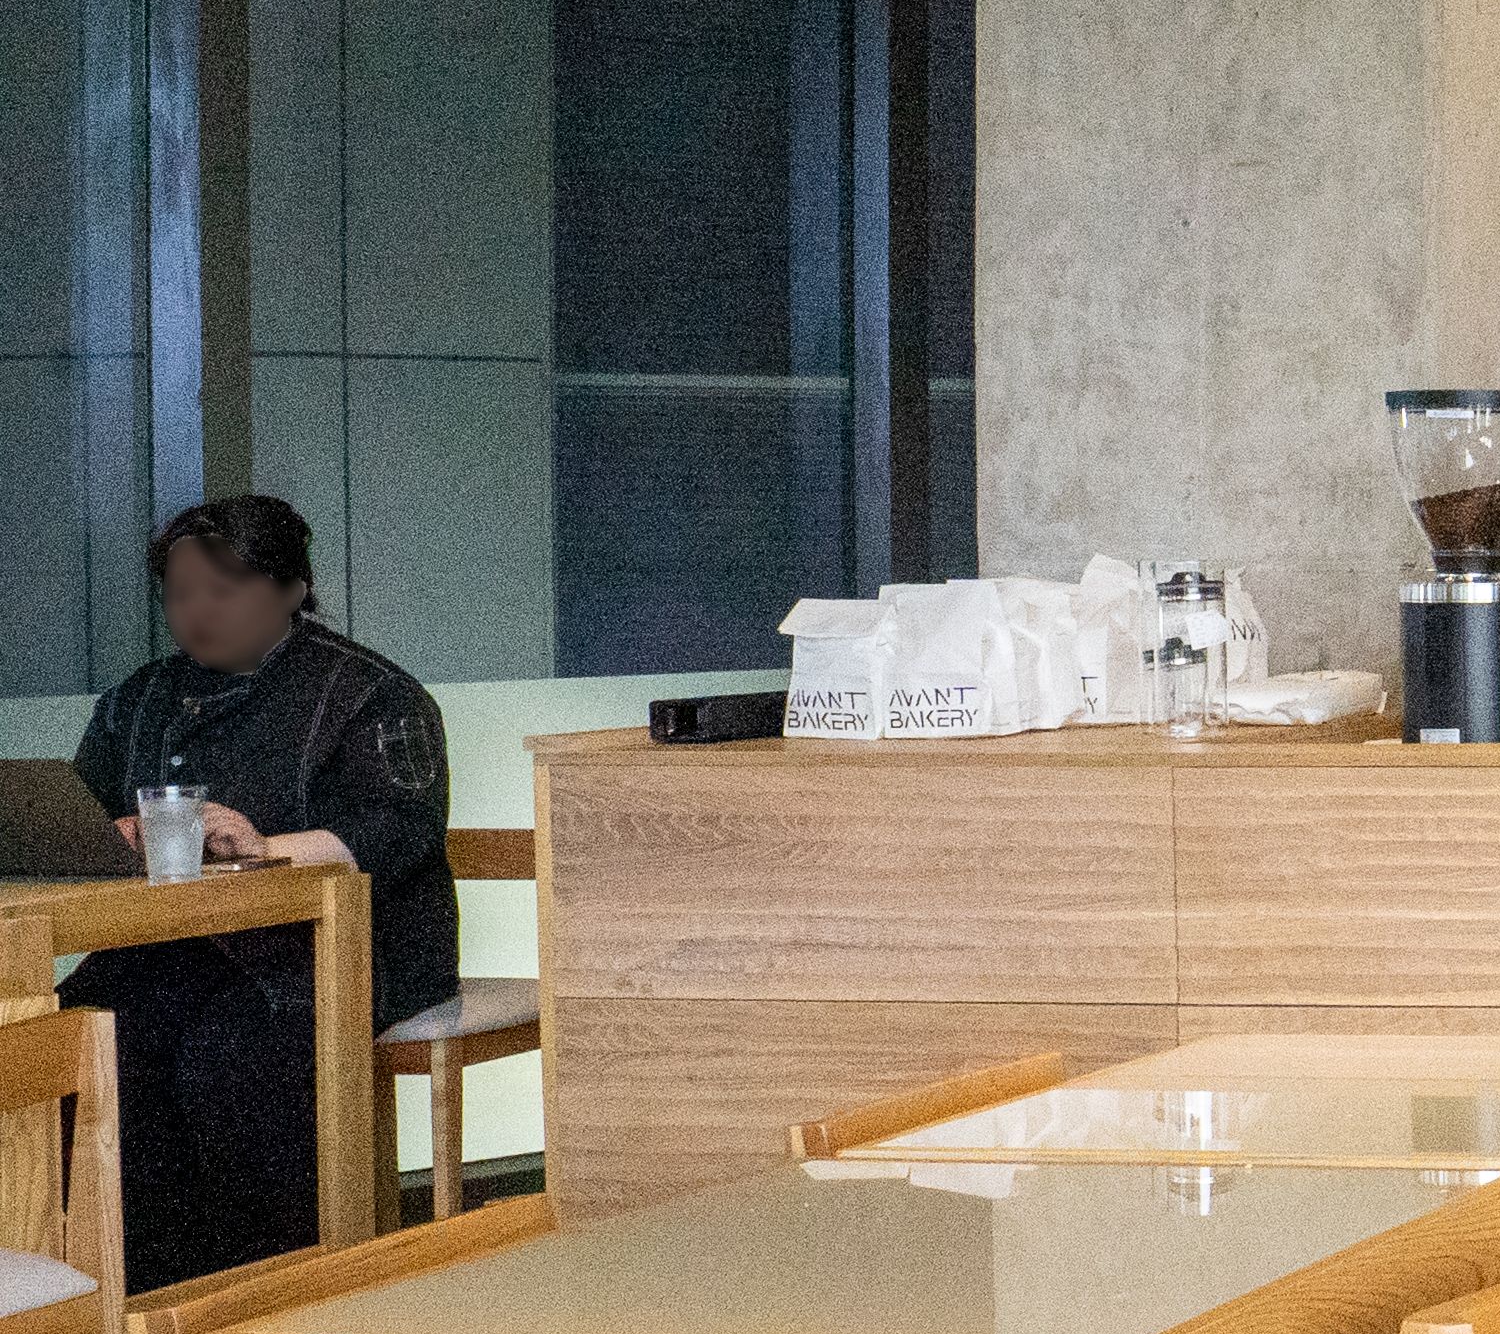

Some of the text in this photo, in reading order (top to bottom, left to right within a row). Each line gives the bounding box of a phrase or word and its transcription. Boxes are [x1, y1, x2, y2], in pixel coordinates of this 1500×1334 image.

[789, 689, 867, 709] AVANT
[889, 687, 977, 707] AVANT
[788, 710, 869, 731] BAKERY
[890, 709, 979, 729] BAKERY
